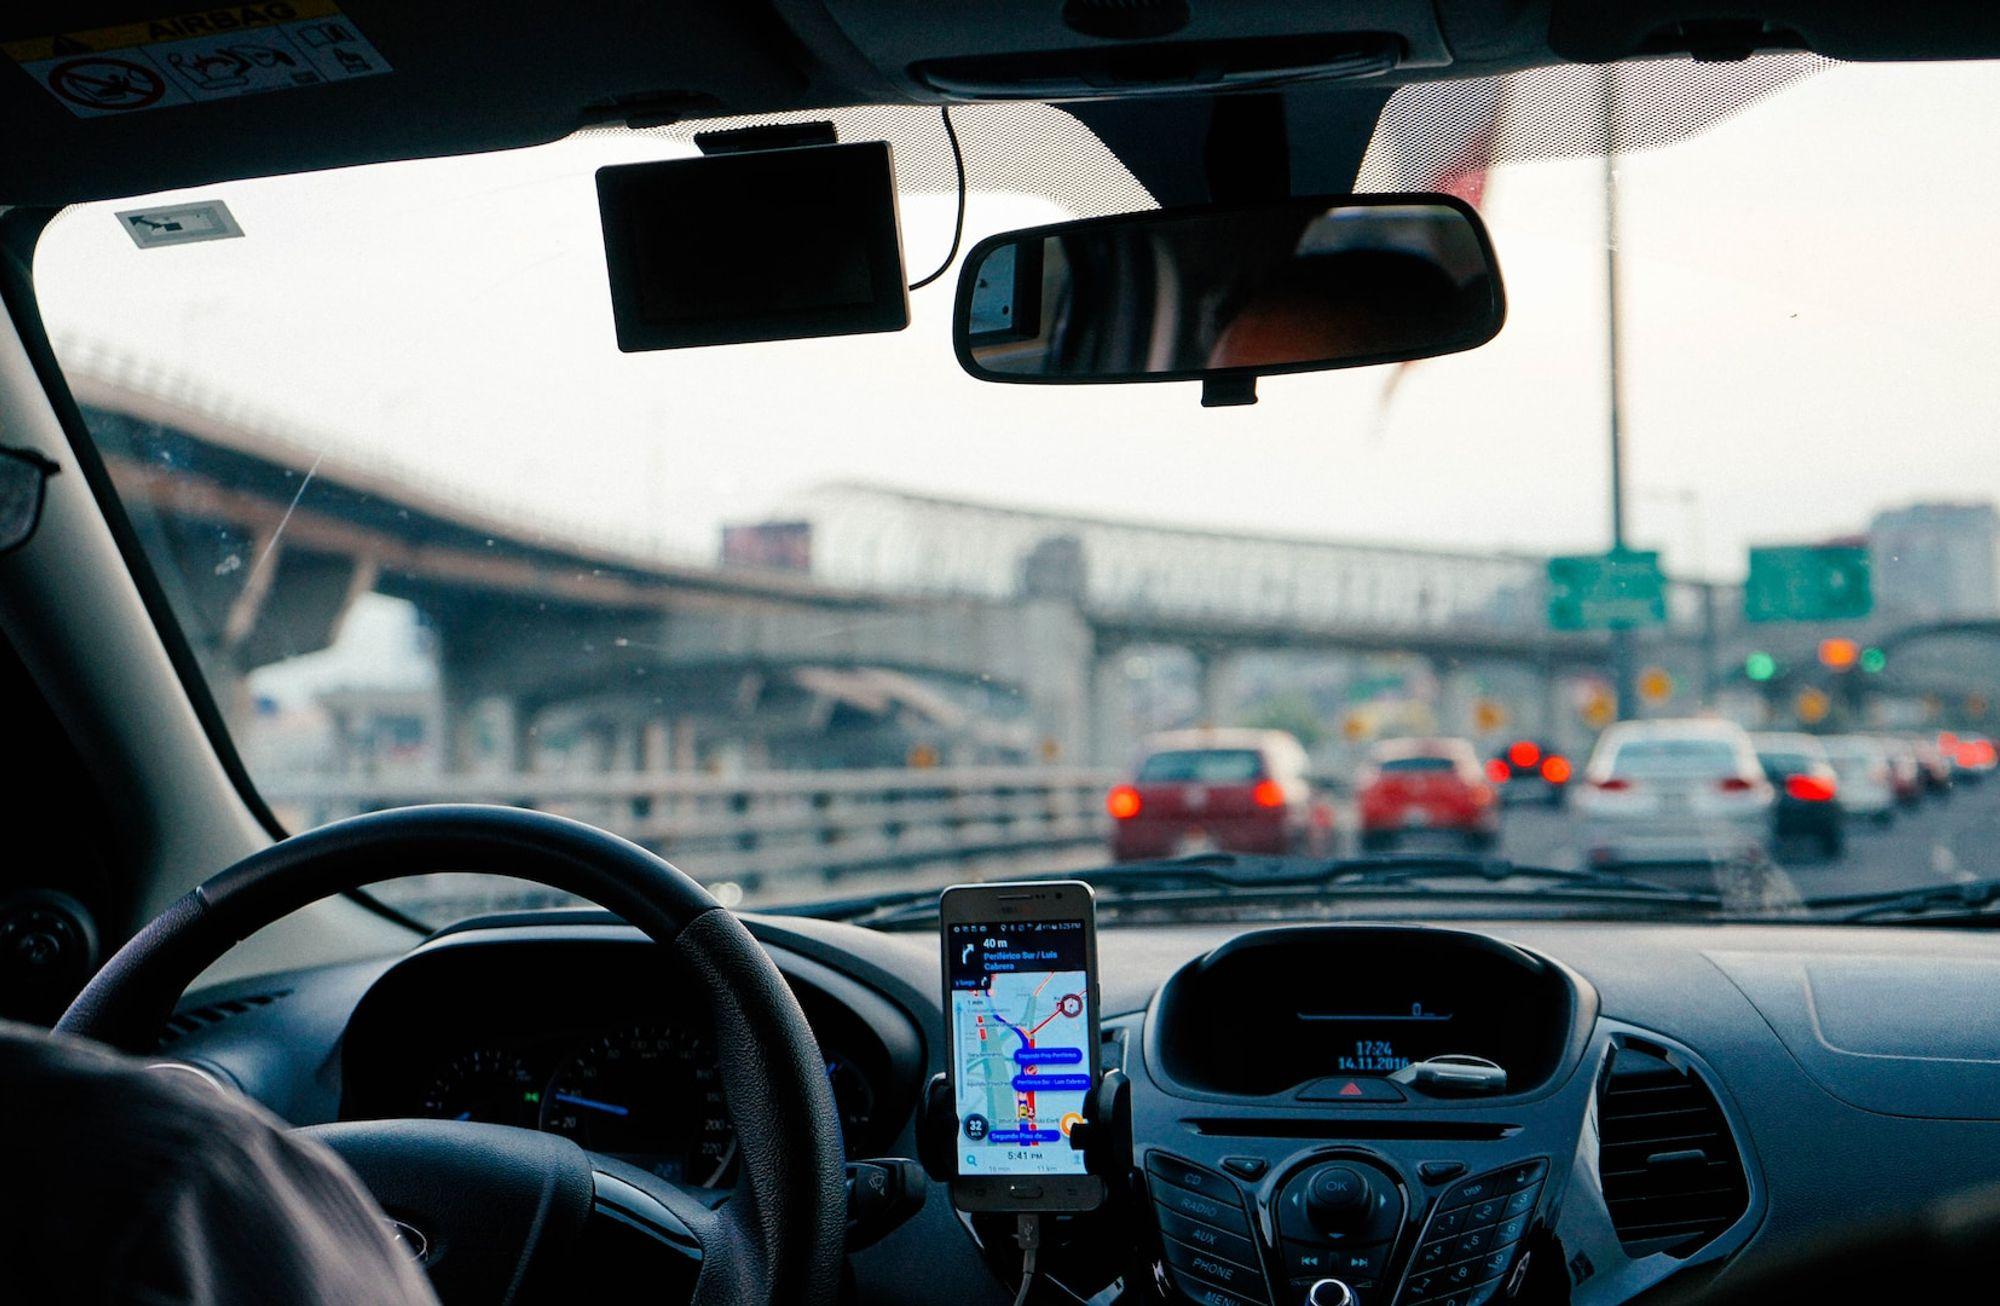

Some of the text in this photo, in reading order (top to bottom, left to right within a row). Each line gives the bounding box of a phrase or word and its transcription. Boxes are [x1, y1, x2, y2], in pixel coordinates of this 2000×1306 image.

[147, 2, 297, 39] AIRBAG
[983, 938, 1008, 948] 40 m
[1022, 952, 1035, 960] Sur
[1041, 951, 1058, 959] Luis
[984, 962, 1015, 971] Cabrera
[1356, 1040, 1392, 1056] 17:24
[1337, 1056, 1410, 1070] 14.11.2016
[969, 1120, 982, 1131] 32
[1007, 1152, 1028, 1160] 5:41
[1184, 1172, 1202, 1185] CD
[1326, 1181, 1348, 1191] OK
[1519, 1193, 1529, 1203] 3
[1181, 1198, 1218, 1217] RADIO
[1483, 1205, 1493, 1216] 2
[1448, 1216, 1455, 1225] 1
[1507, 1222, 1517, 1233] 6
[1192, 1229, 1217, 1245] AUX
[1470, 1235, 1480, 1246] 5
[1433, 1246, 1443, 1255] 4
[1495, 1254, 1504, 1265] 9
[1191, 1257, 1234, 1280] PHONE
[1458, 1266, 1468, 1278] 8
[1422, 1278, 1432, 1288] 7
